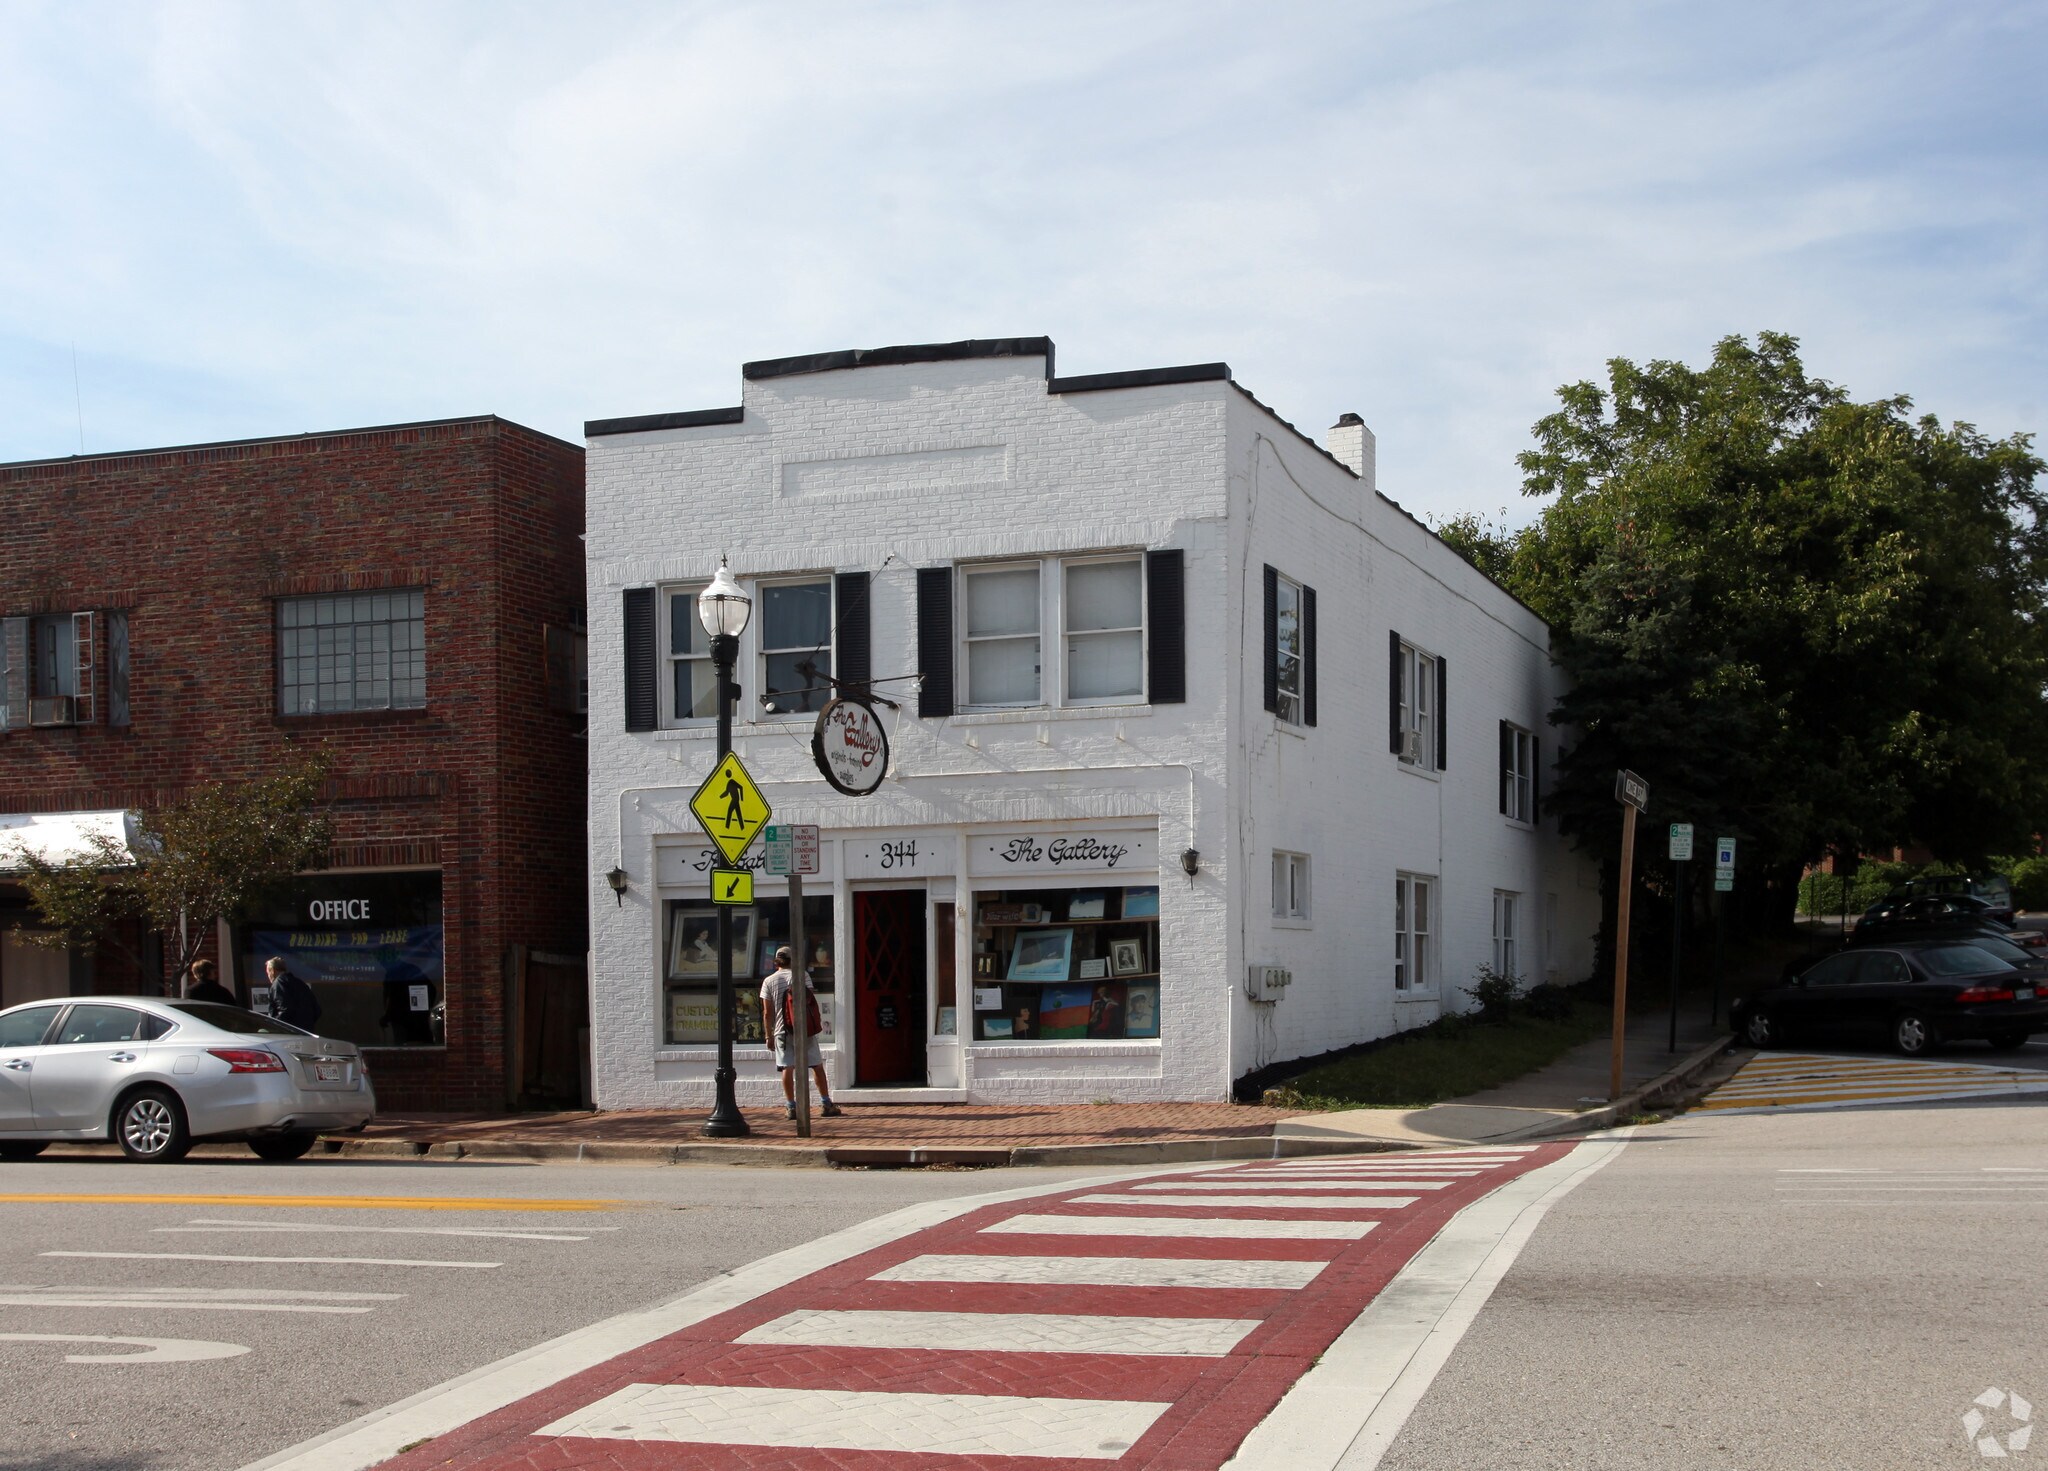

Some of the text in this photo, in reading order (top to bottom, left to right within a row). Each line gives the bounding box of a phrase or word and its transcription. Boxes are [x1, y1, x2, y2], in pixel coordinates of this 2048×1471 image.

[844, 712, 880, 767] Gallery
[769, 829, 774, 838] 2
[1672, 826, 1677, 836] 2
[881, 839, 920, 869] 344
[1000, 836, 1128, 867] The Gallery
[309, 899, 370, 921] OFFICE
[289, 929, 408, 947] BUILDING FOR LEASE
[676, 1005, 720, 1017] CUSTOM
